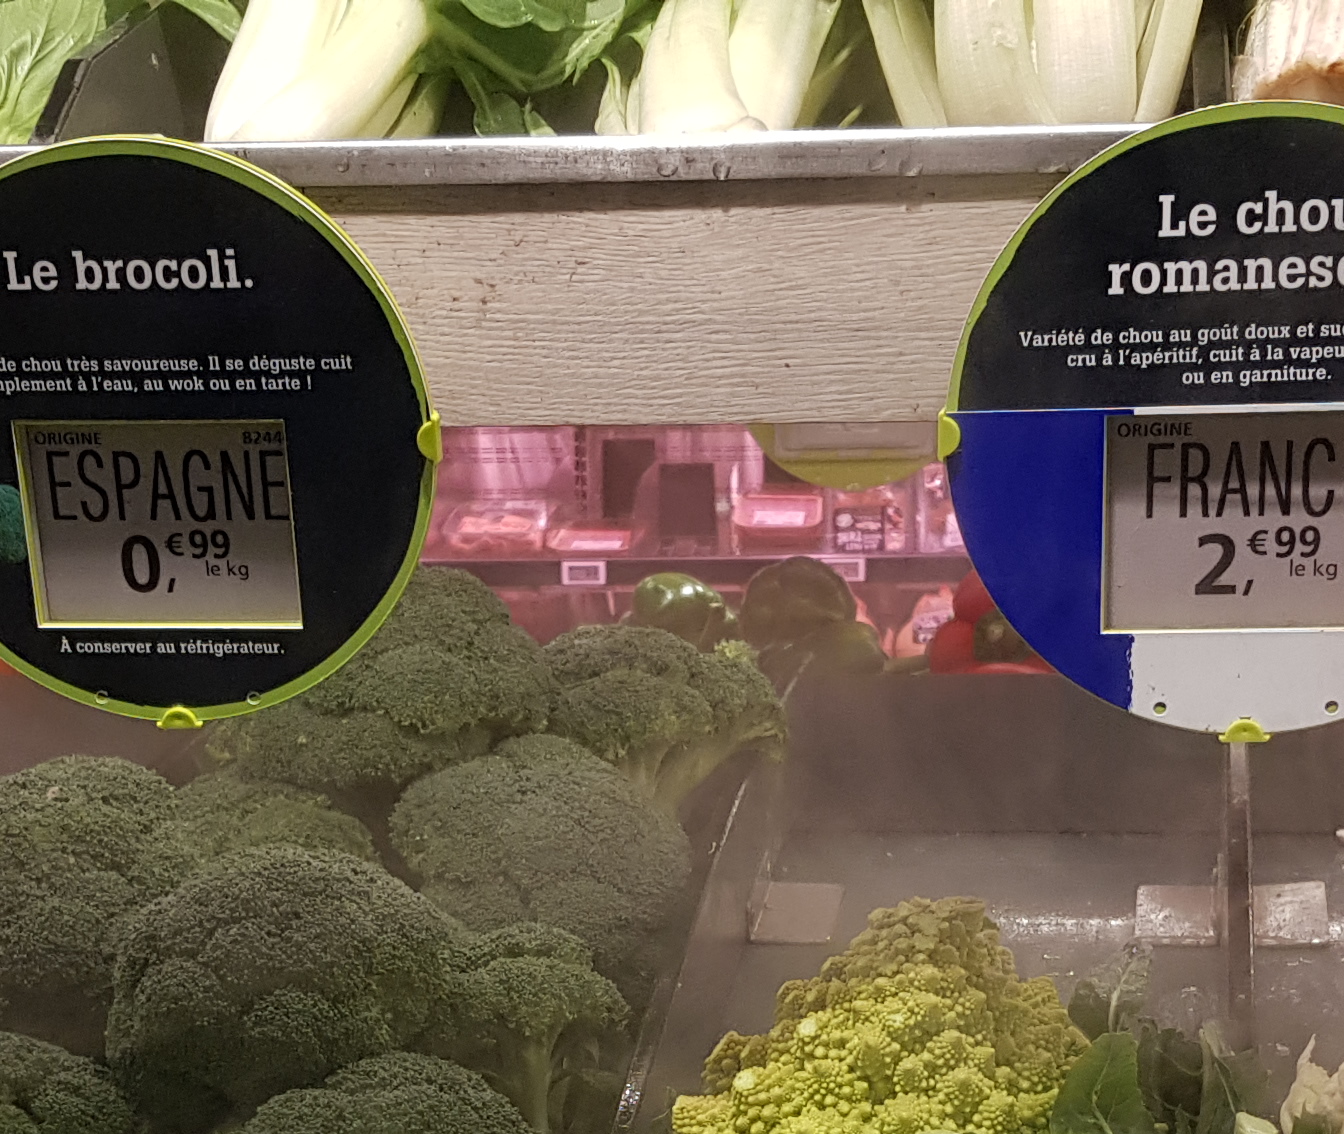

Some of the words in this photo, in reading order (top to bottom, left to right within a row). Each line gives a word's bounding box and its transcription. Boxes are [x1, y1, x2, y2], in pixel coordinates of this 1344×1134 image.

[1158, 195, 1216, 238] Le
[2, 250, 58, 291] Le
[72, 249, 253, 290] brocoli.
[1019, 329, 1085, 348] Variété
[1091, 327, 1112, 344] de
[1118, 326, 1164, 343] chou
[1169, 328, 1192, 341] au
[1198, 324, 1239, 345] goût
[1244, 322, 1291, 340] doux
[1296, 322, 1315, 337] et
[21, 357, 62, 372] chou
[66, 356, 99, 372] très
[103, 358, 204, 371] savoureuse.
[225, 358, 244, 370] se
[249, 355, 315, 374] déguste
[320, 355, 353, 370] cuit
[1067, 352, 1096, 367] cru
[1102, 349, 1112, 366] à
[1210, 346, 1245, 362] cuit
[1250, 344, 1261, 360] à
[1266, 343, 1285, 360] la
[77, 376, 87, 392] à
[143, 379, 164, 391] au
[168, 377, 204, 391] wok
[209, 378, 230, 391] ou
[235, 378, 257, 391] en
[261, 376, 300, 391] tarte
[1182, 371, 1204, 384] ou
[1210, 369, 1234, 384] en
[1239, 364, 1332, 386] garniture.
[35, 432, 102, 445] ORIGINE
[1118, 421, 1192, 437] ORIGINE
[46, 450, 291, 522] ESPAGNE
[205, 560, 220, 577] le
[227, 560, 249, 580] kg
[1289, 559, 1305, 577] le
[1313, 559, 1338, 580] kg
[60, 636, 71, 653] À
[76, 640, 152, 653] conserver
[157, 641, 176, 653] au
[180, 639, 285, 657] réfrigérateur.
